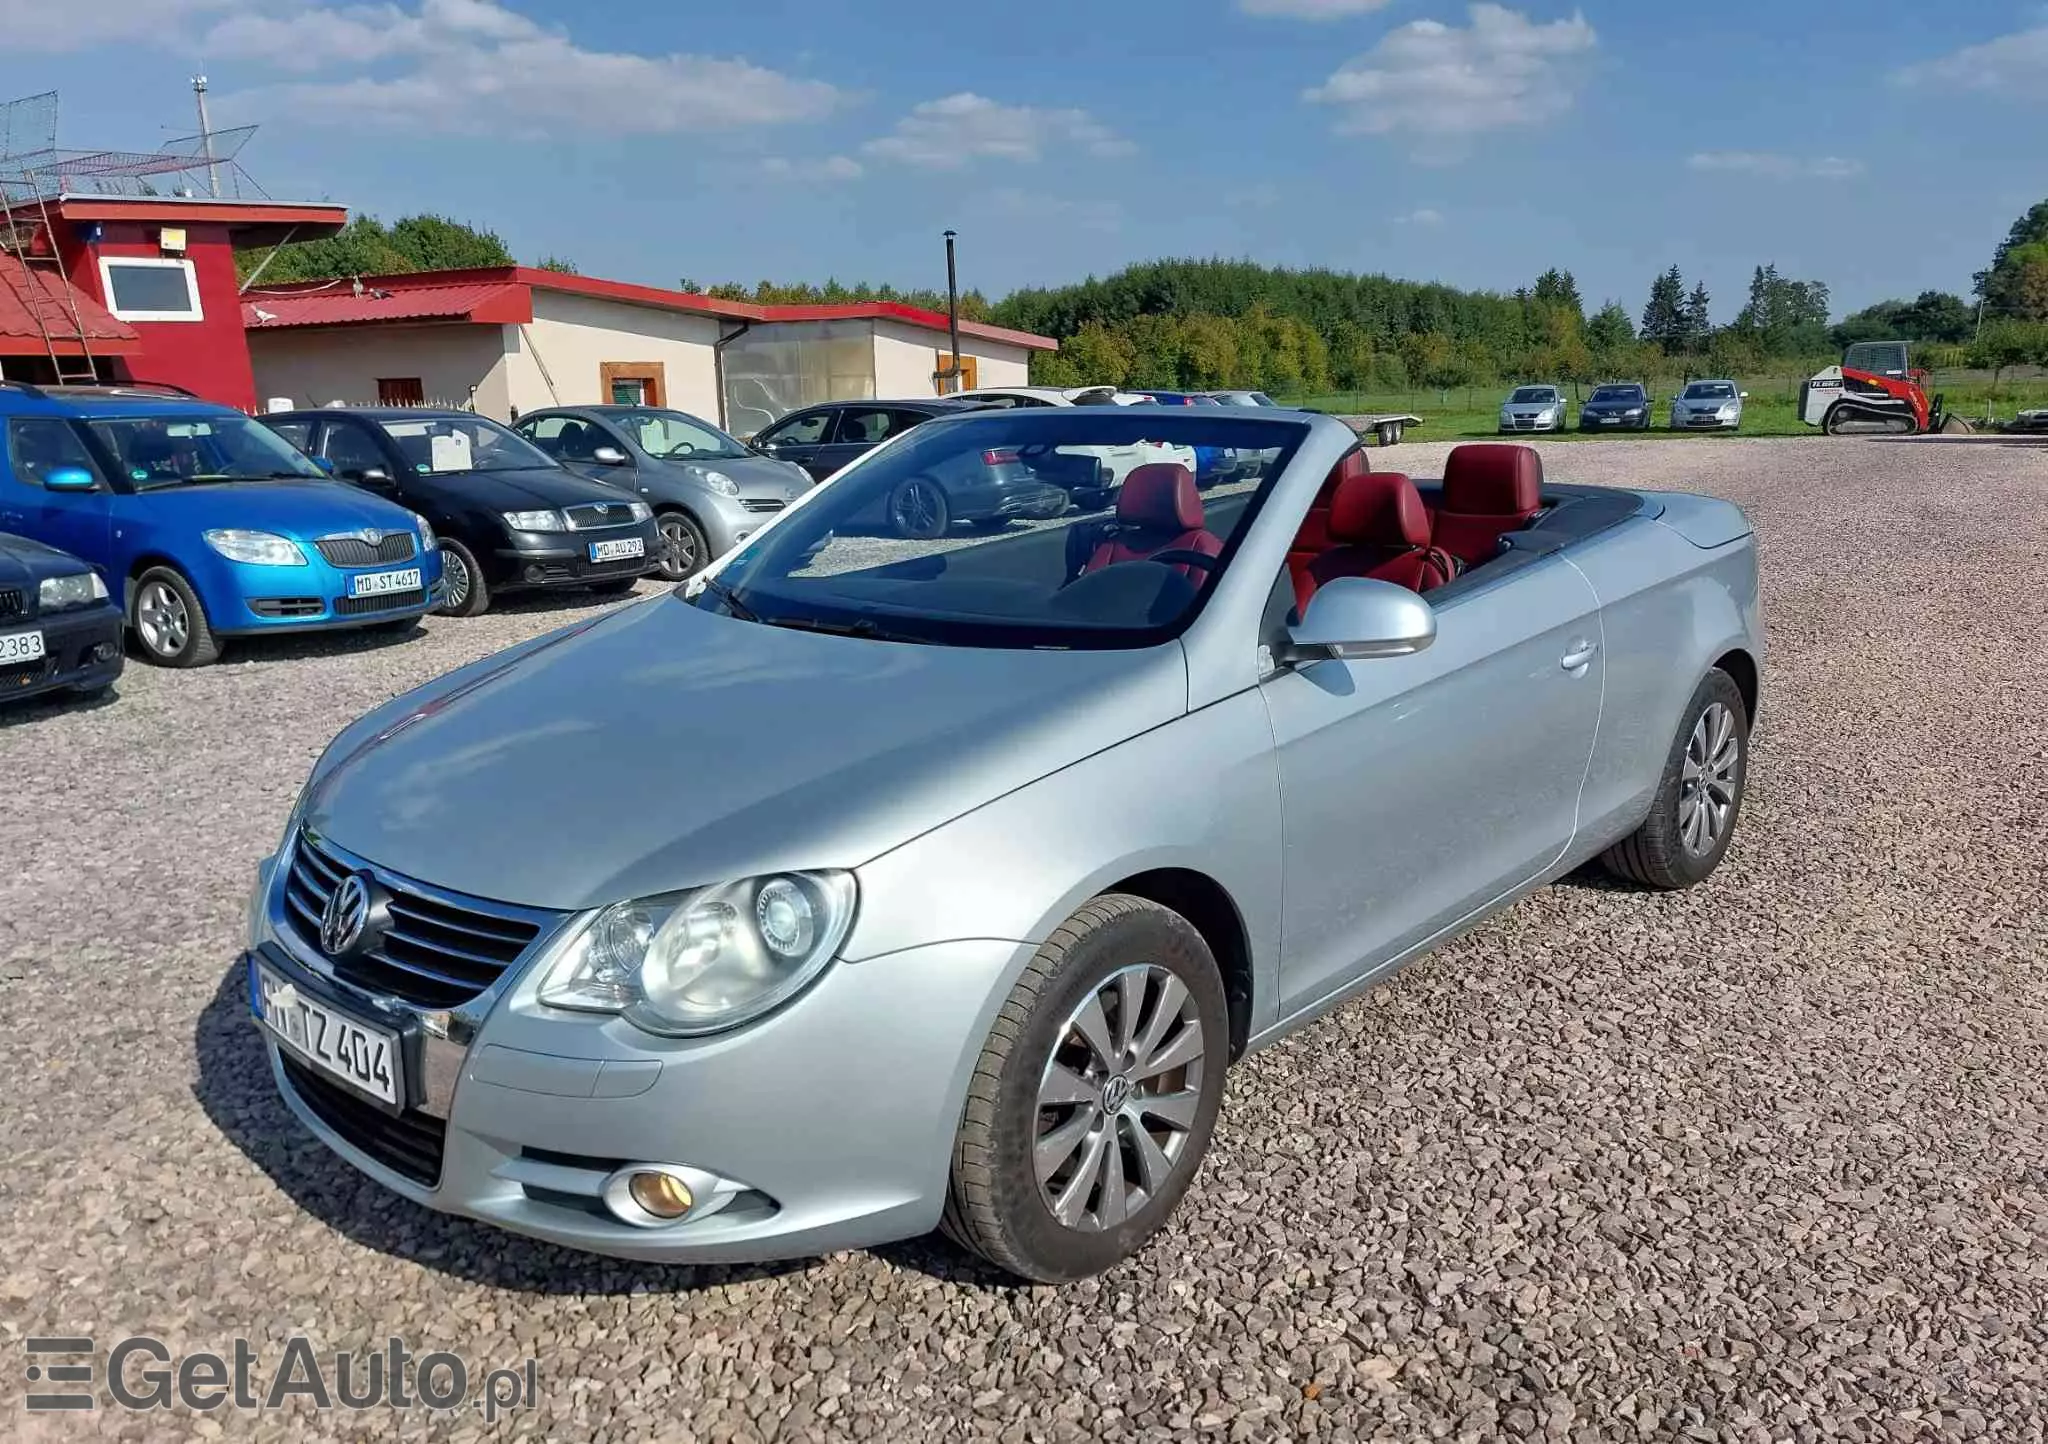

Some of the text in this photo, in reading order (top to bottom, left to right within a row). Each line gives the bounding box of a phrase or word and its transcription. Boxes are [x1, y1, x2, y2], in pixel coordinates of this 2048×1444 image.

[597, 544, 609, 556] MD
[615, 542, 626, 553] AU
[357, 571, 419, 592] MD ST 4617
[298, 1000, 332, 1063] TZ
[338, 1024, 390, 1093] 404
